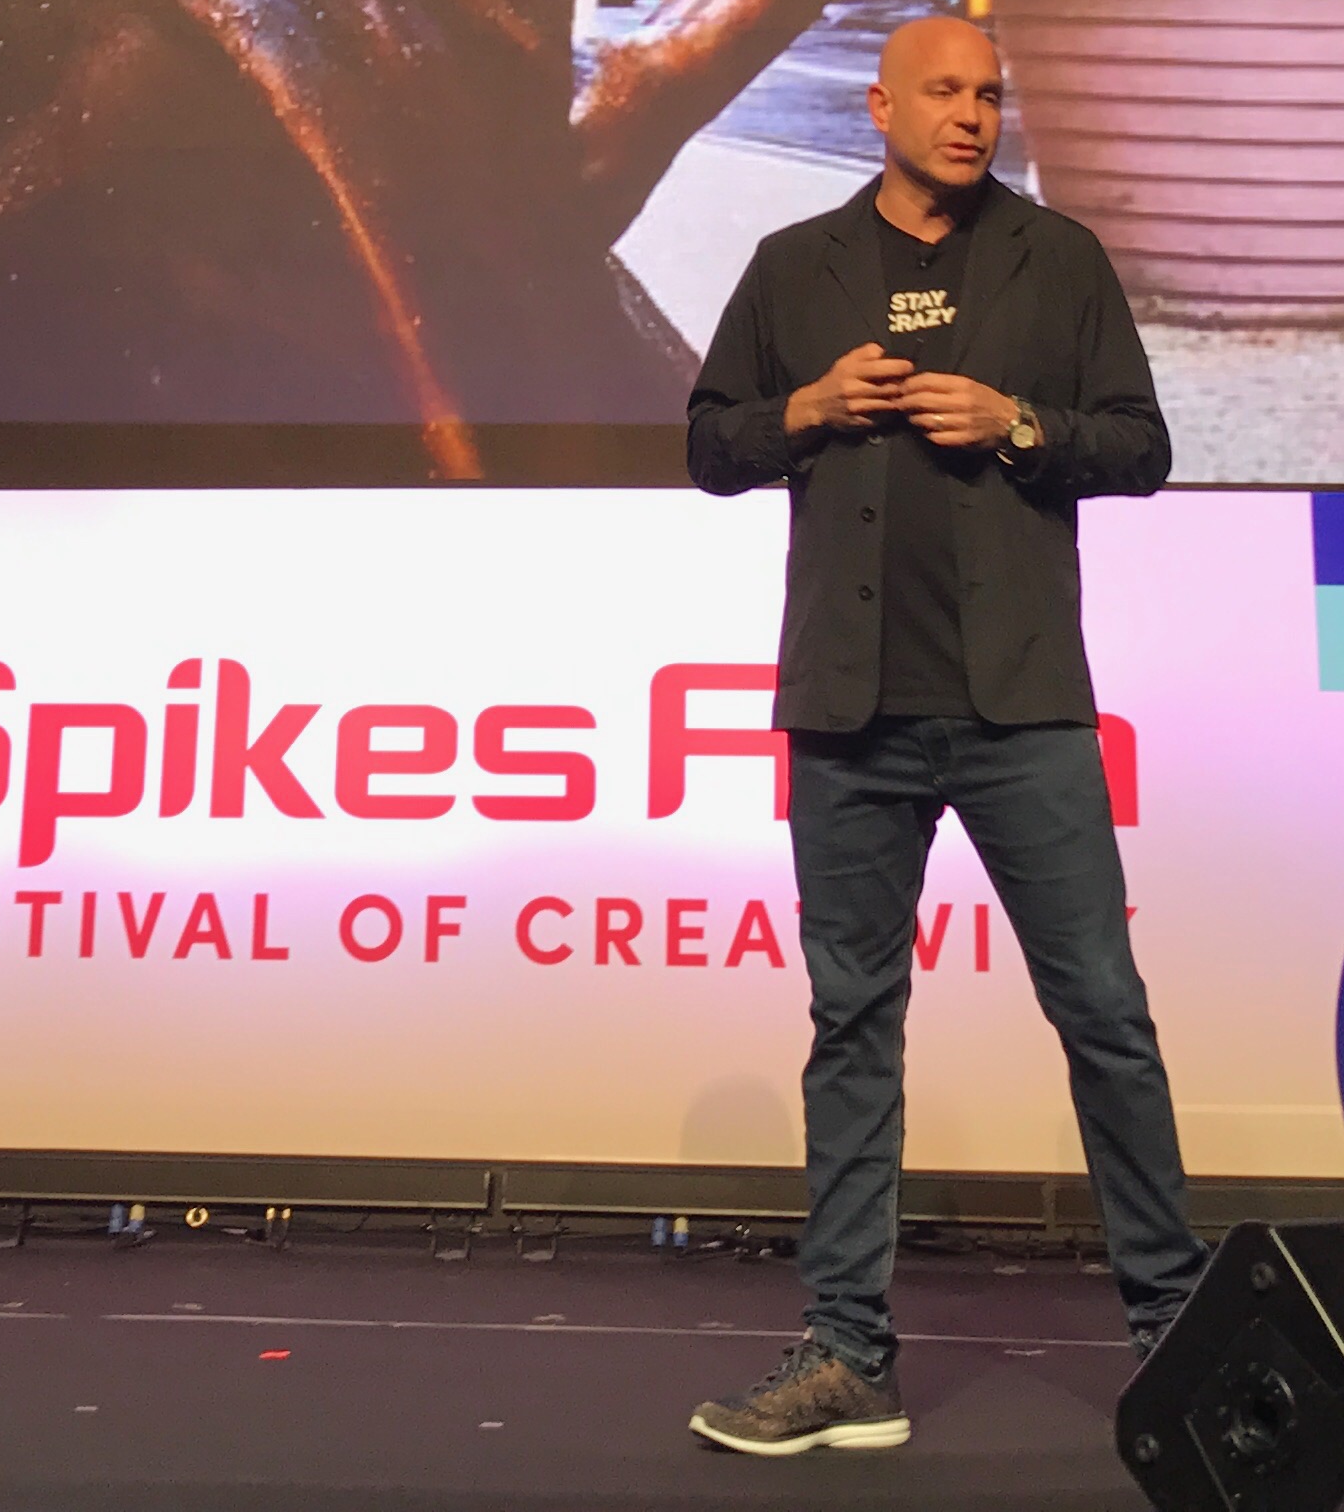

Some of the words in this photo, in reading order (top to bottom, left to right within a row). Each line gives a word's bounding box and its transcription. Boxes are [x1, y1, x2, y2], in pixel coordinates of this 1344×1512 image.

[889, 289, 948, 312] STAY
[339, 893, 468, 963] OF
[515, 895, 1138, 972] CREAVI
